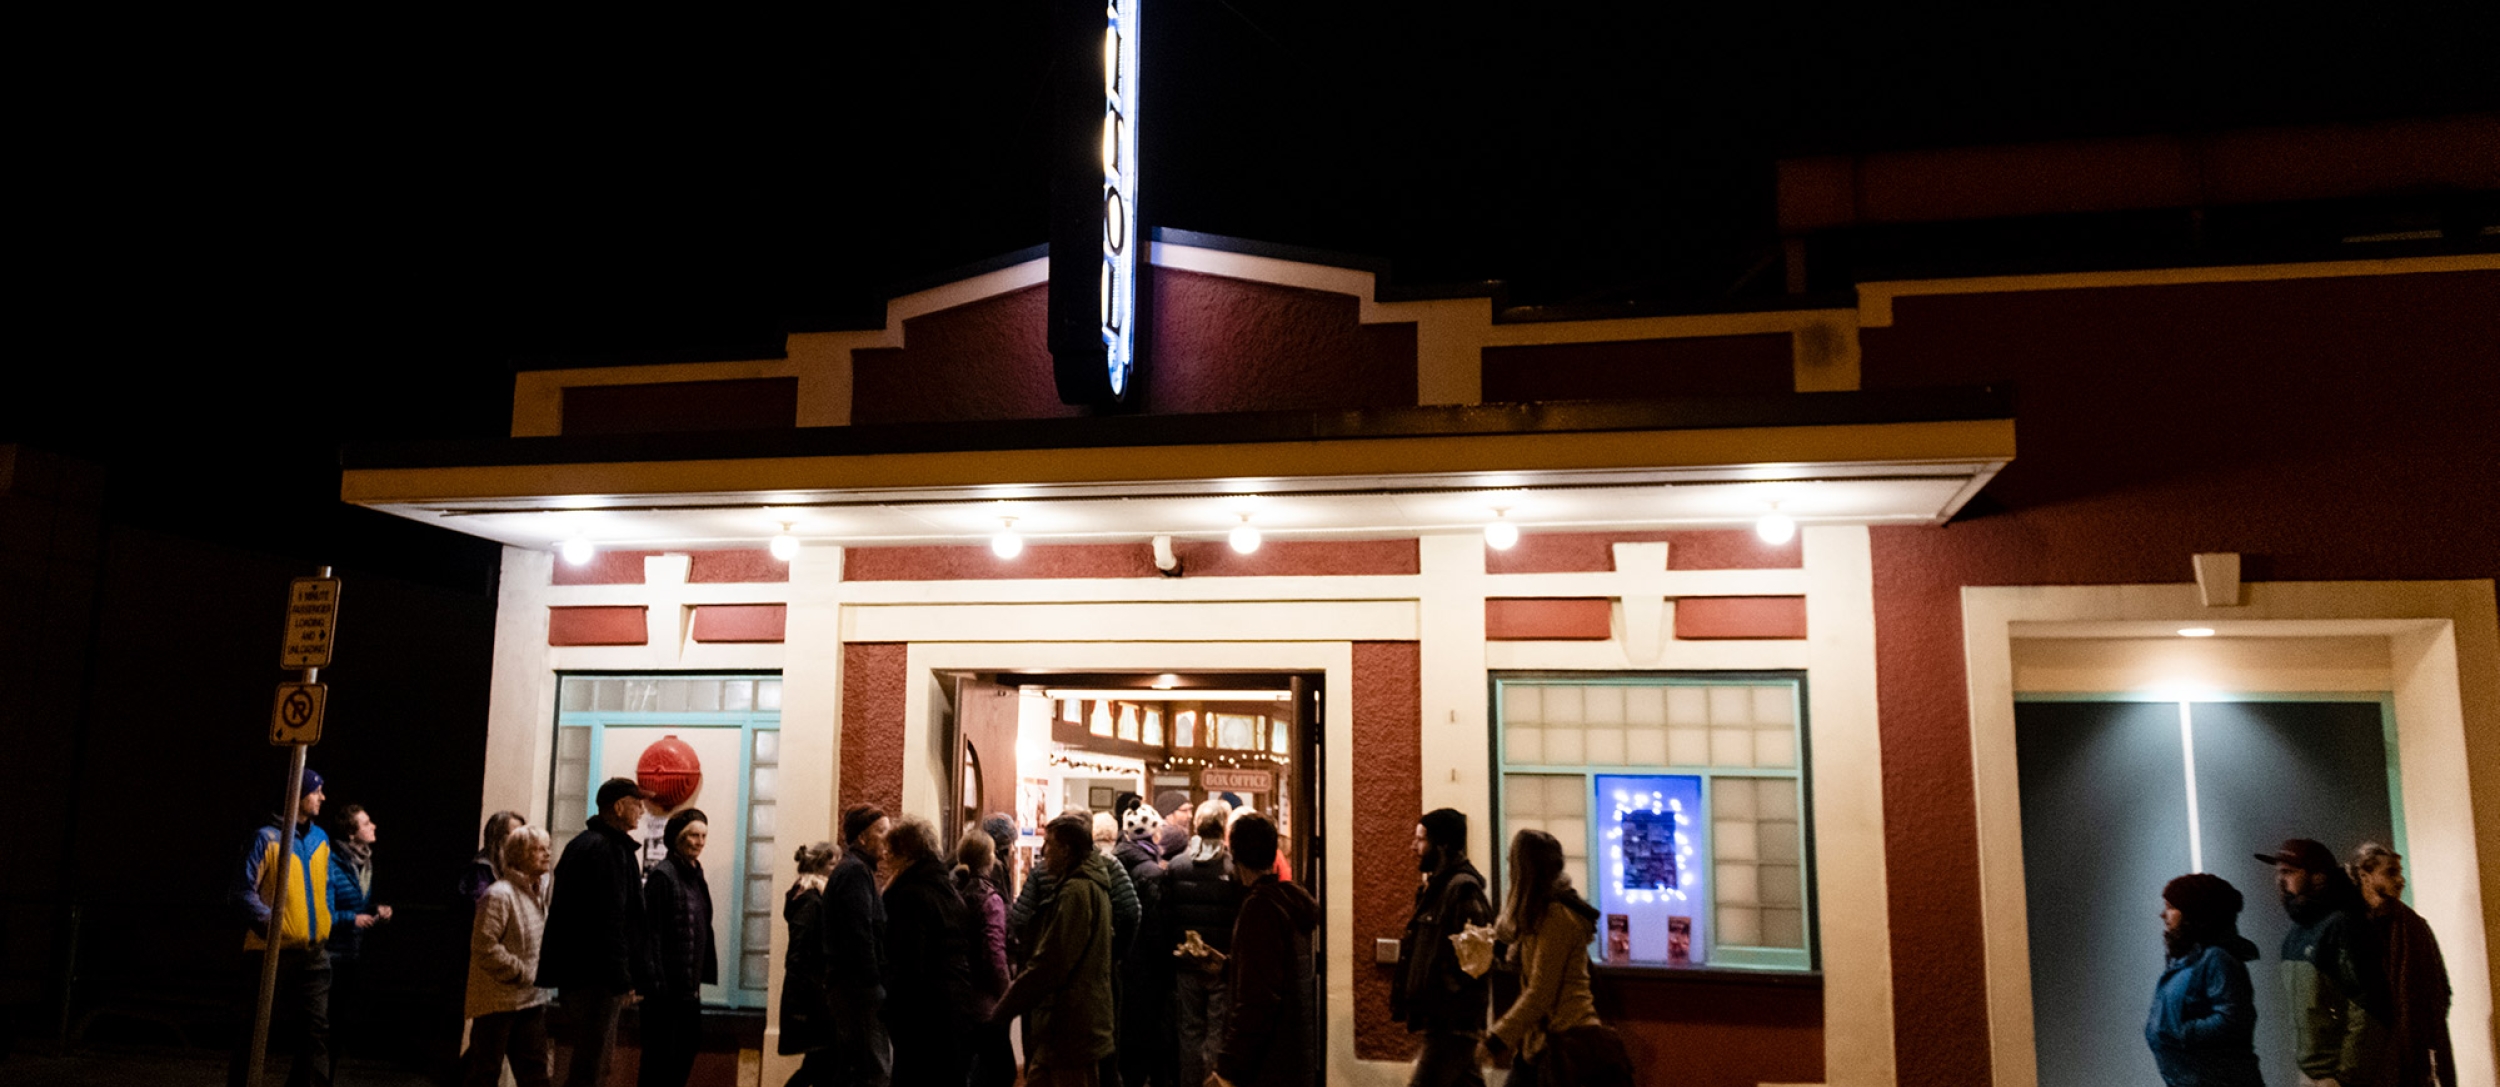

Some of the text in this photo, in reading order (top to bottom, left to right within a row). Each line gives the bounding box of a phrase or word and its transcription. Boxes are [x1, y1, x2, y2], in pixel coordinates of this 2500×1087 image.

[294, 618, 324, 628] LOADING
[302, 630, 315, 640] AND
[288, 644, 324, 654] UNLOADING
[1206, 774, 1266, 787] BOX OFFICE
